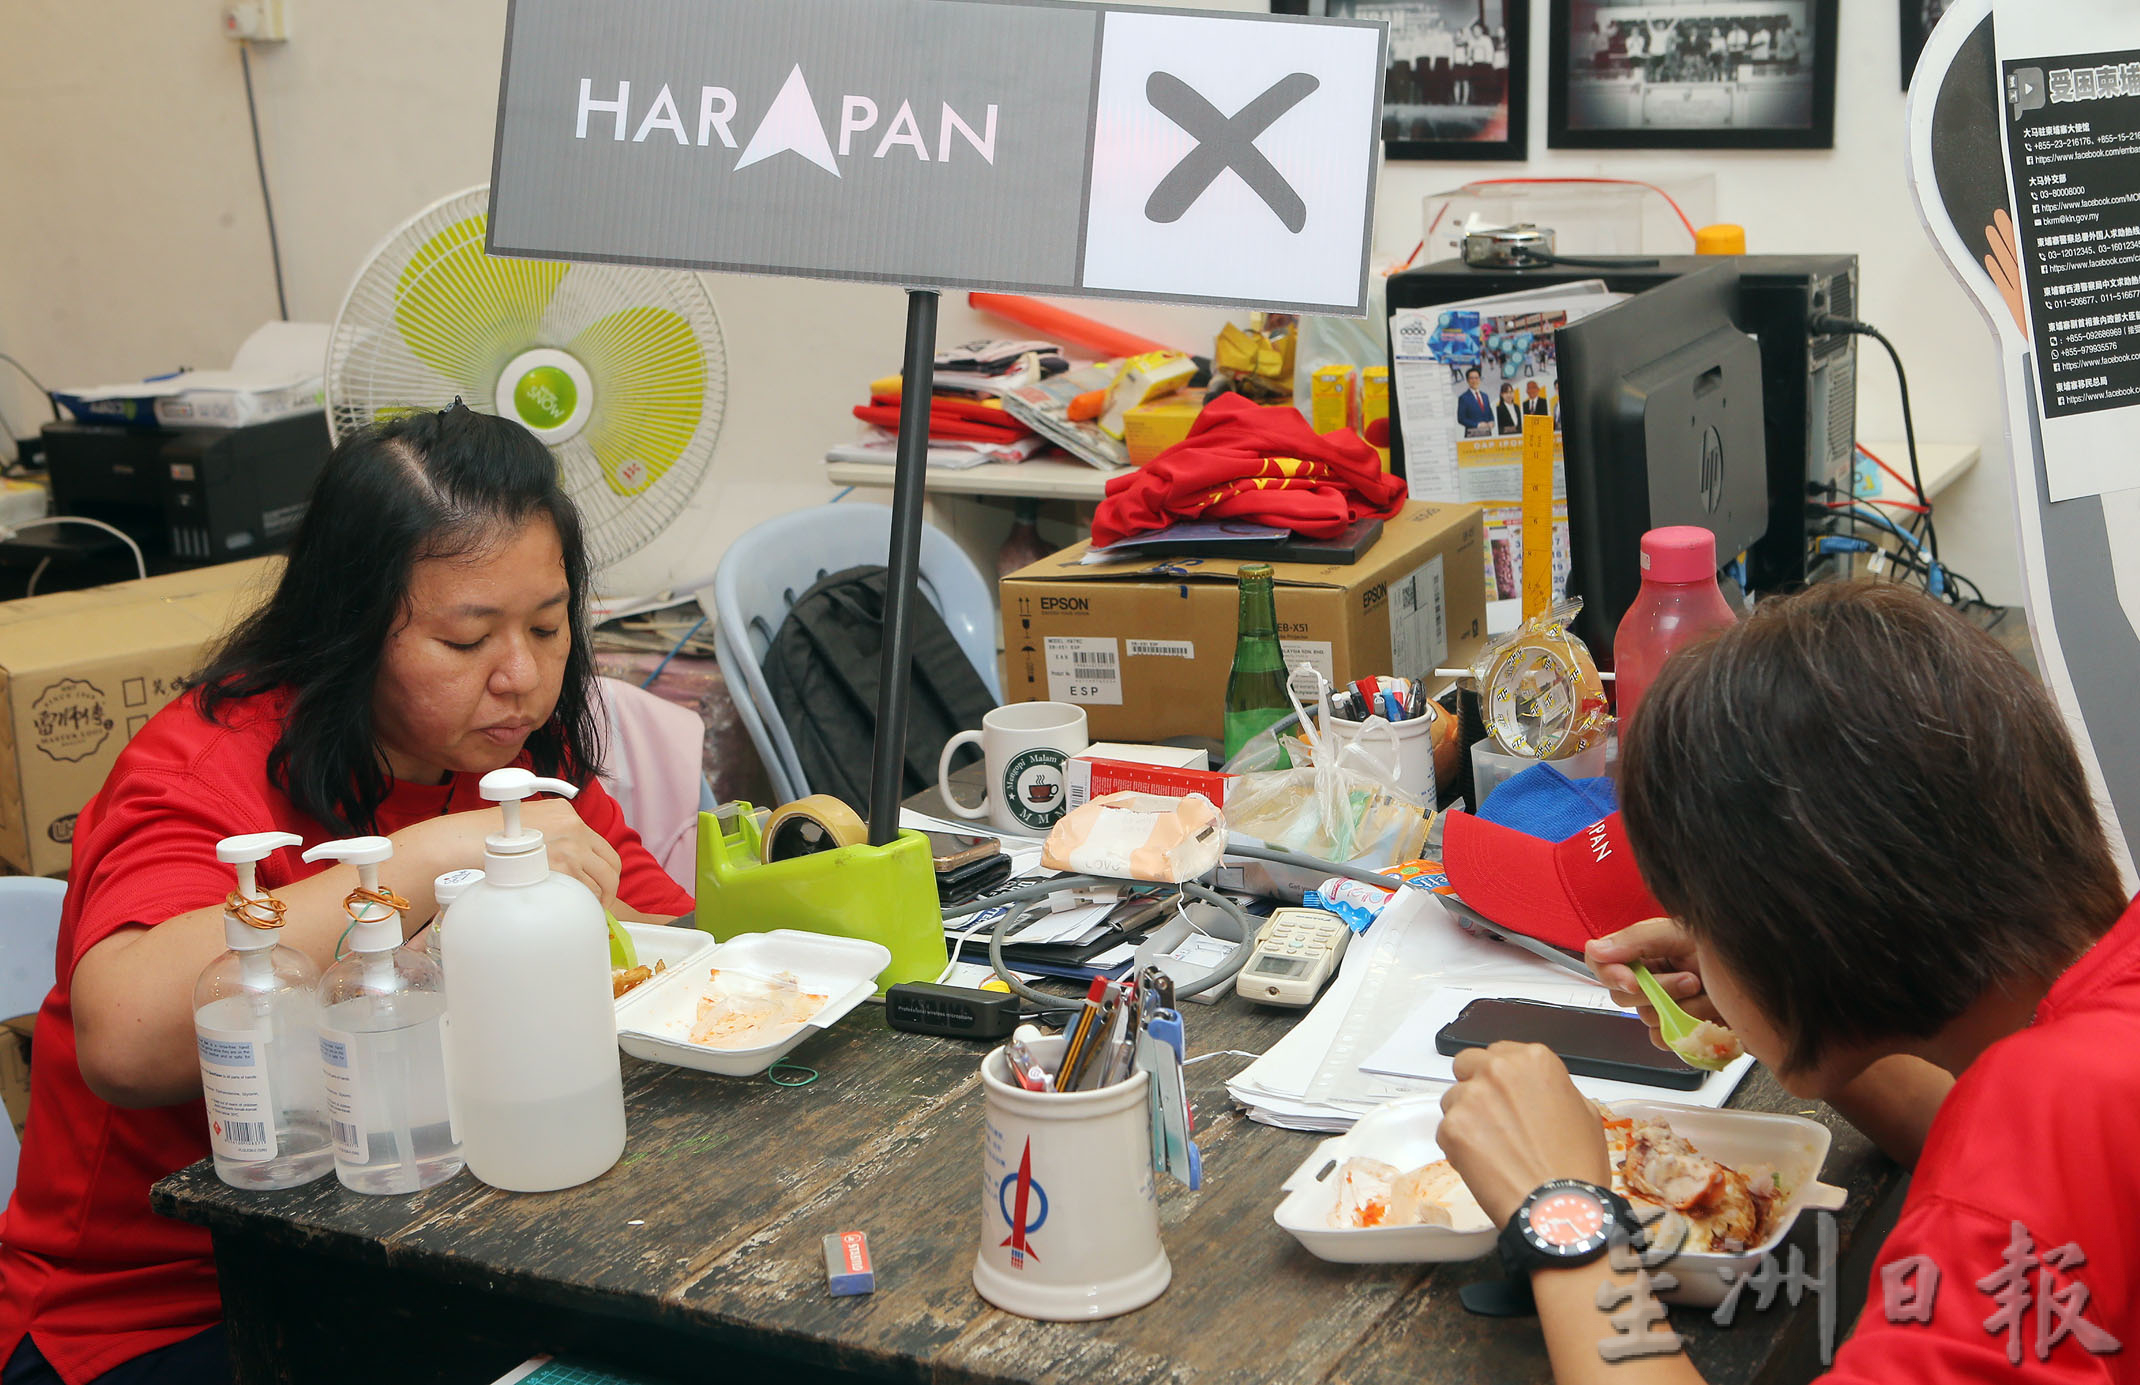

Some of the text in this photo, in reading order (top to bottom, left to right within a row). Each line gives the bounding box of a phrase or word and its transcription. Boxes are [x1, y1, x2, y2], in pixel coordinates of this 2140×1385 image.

[2028, 173, 2067, 187] 大马外交部
[2040, 186, 2085, 199] 03-80008000
[2061, 342, 2117, 357] +855-979935576
[1363, 581, 1388, 608] EPSON
[1040, 597, 1089, 610] EPSON
[1277, 623, 1308, 632] EB-X51
[1006, 754, 1057, 790] Mengopi Malam
[898, 1005, 973, 1021] Professional wireless microphone
